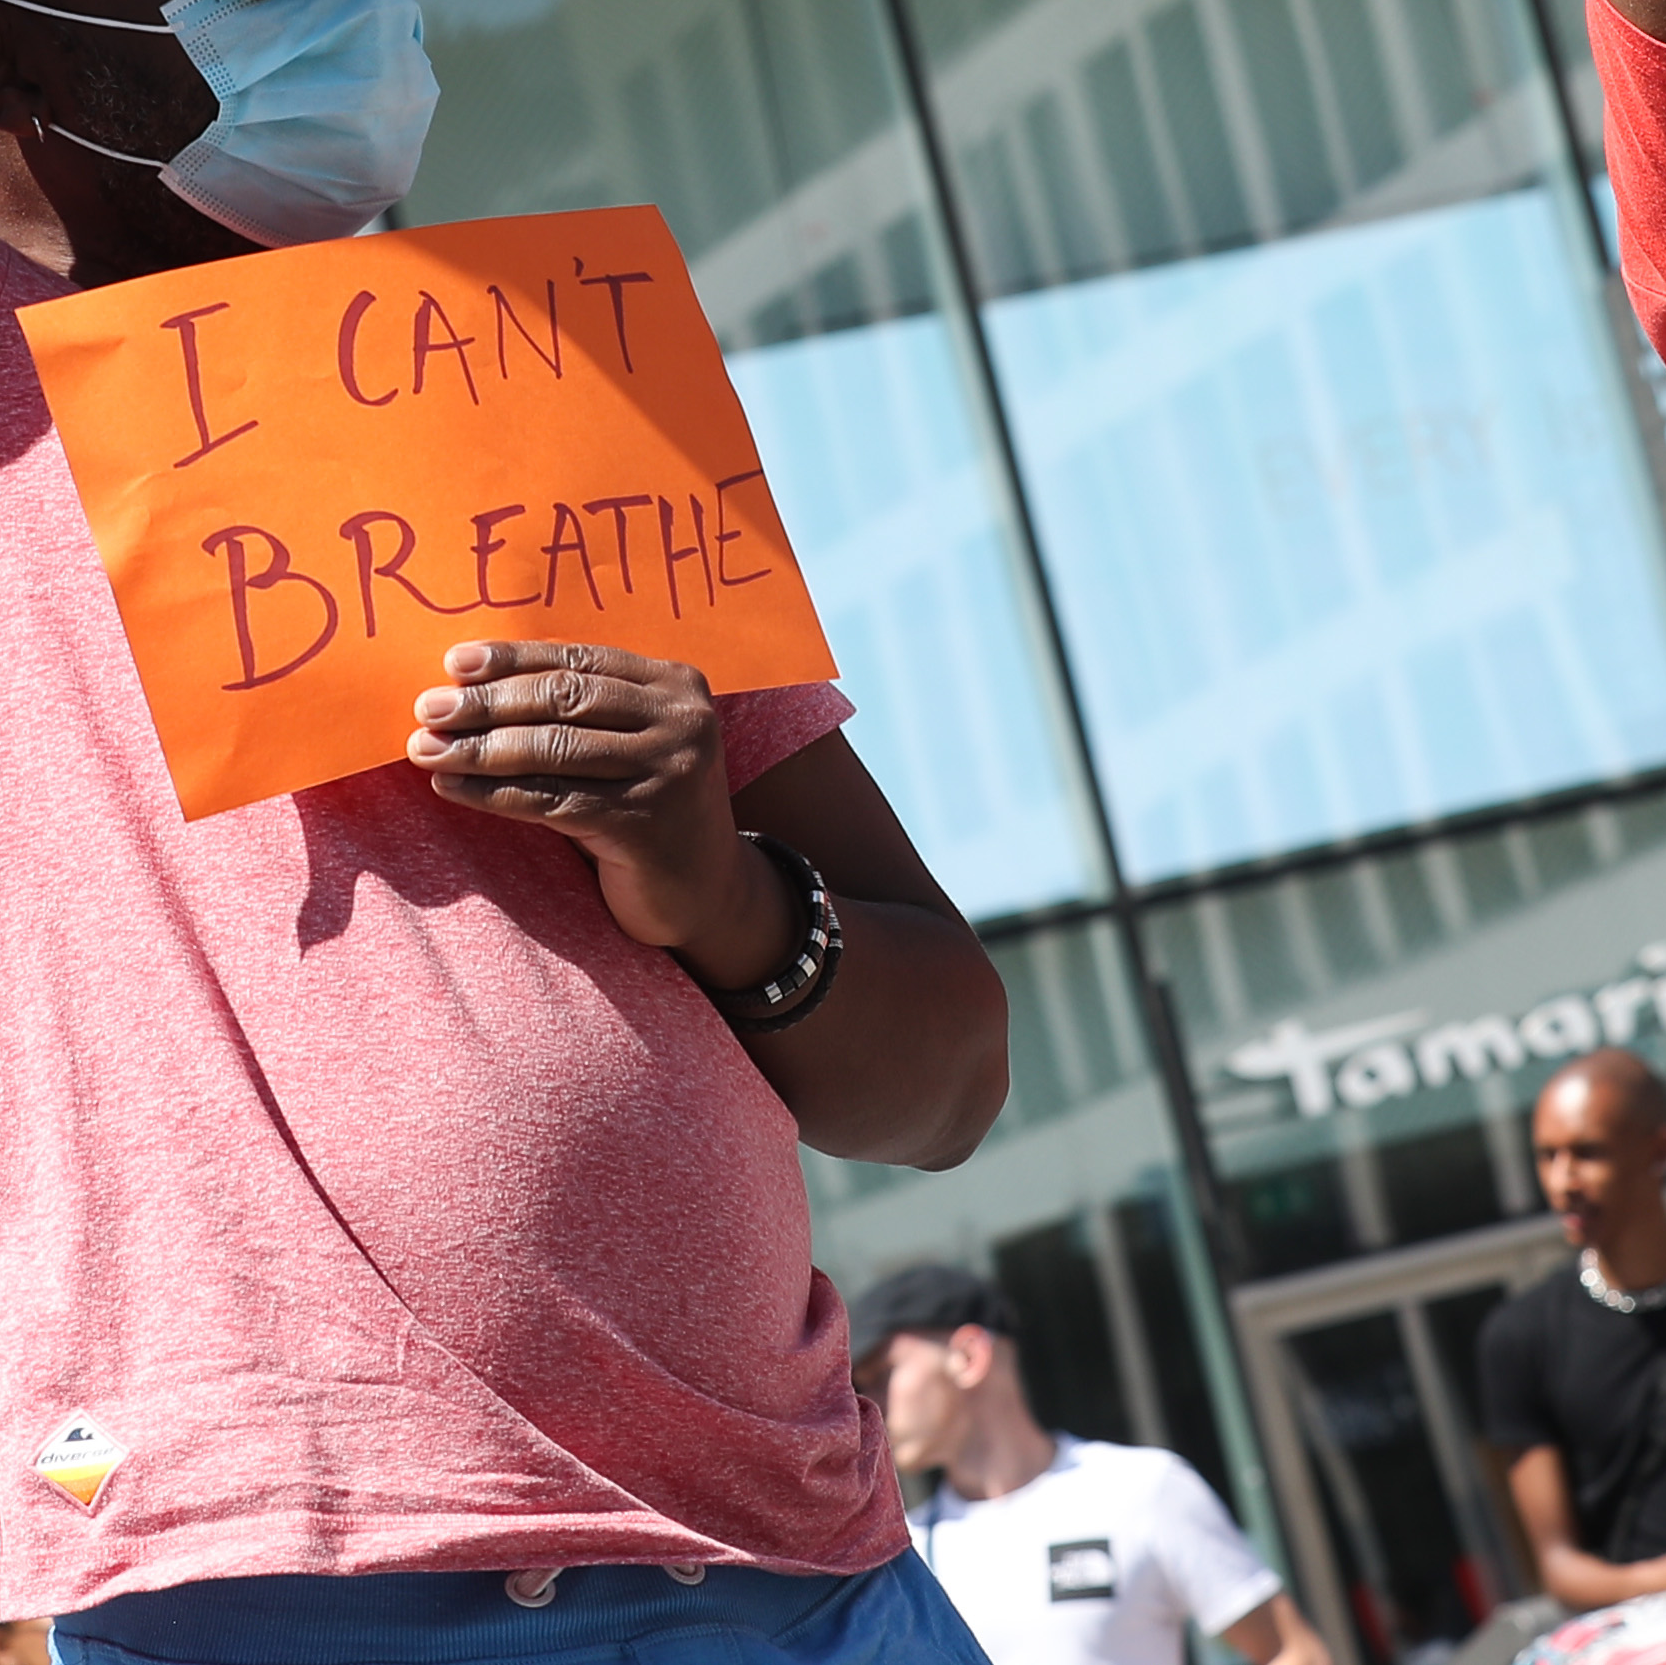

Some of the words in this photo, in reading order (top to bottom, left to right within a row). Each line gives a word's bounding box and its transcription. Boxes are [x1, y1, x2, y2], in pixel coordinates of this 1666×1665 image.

[159, 301, 259, 469] I
[338, 256, 653, 406] CAN'T
[202, 469, 771, 691] BREATHE
